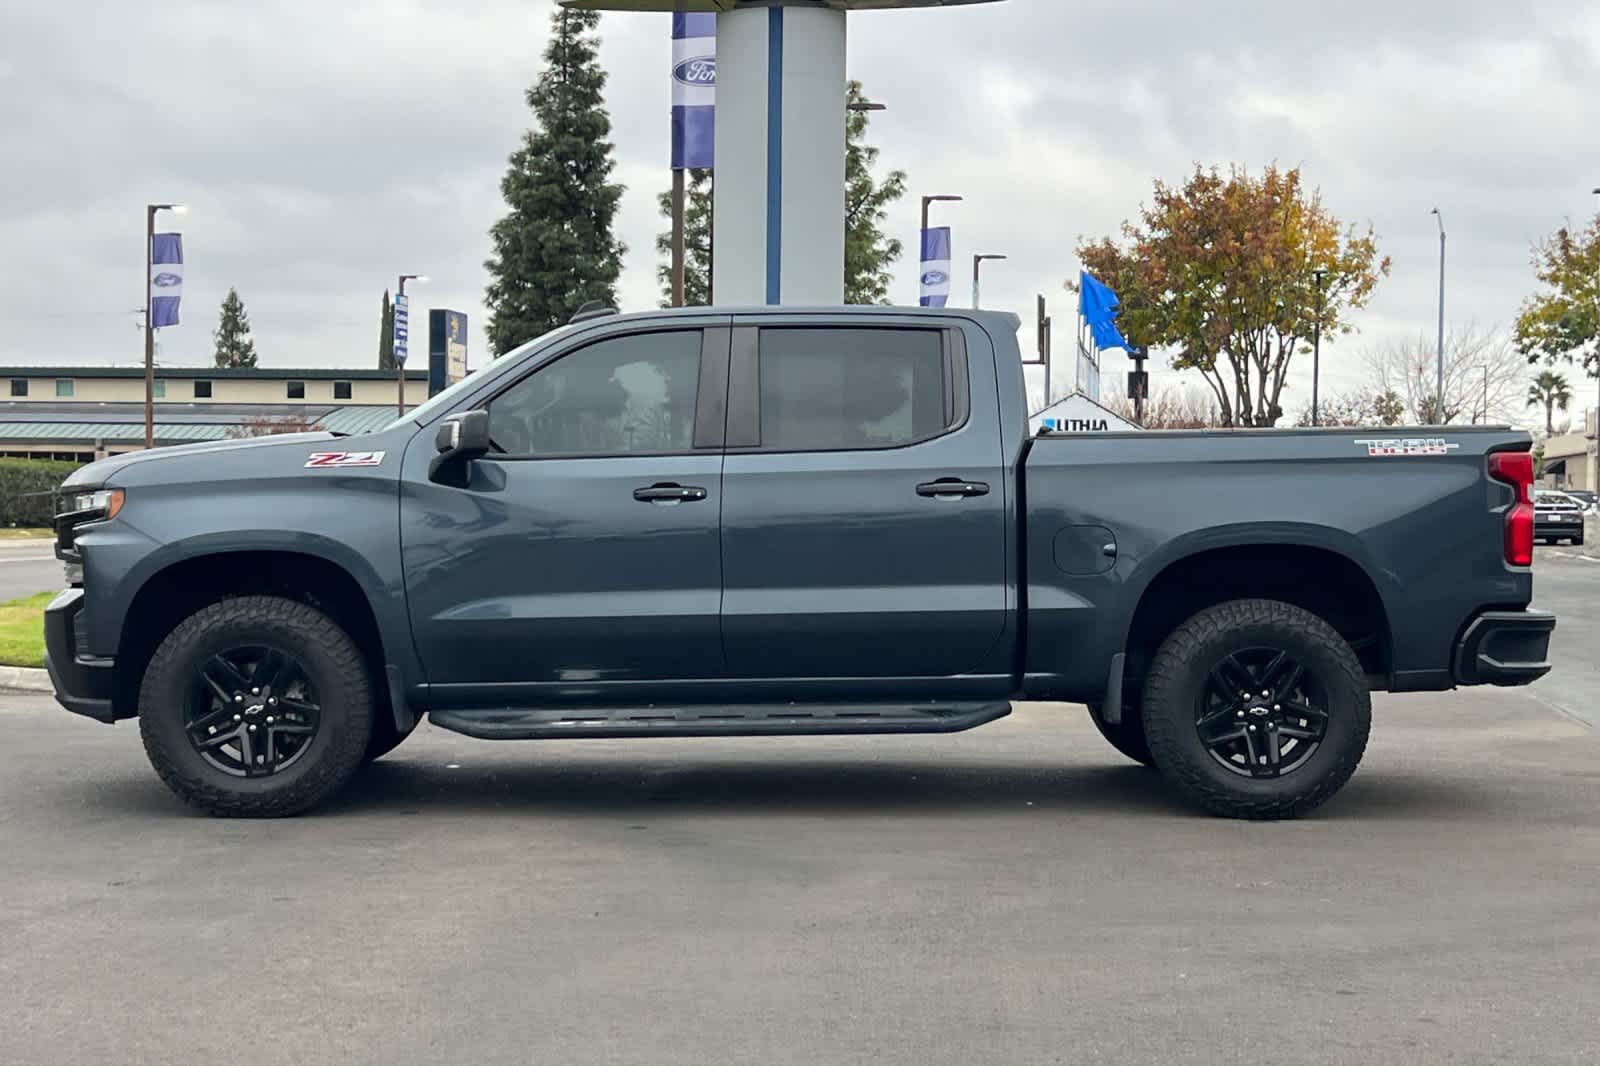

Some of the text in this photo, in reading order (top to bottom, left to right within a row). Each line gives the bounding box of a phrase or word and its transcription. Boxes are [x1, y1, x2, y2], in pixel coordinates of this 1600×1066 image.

[686, 60, 716, 81] For
[1057, 419, 1108, 431] LITHIA
[303, 450, 386, 468] Z71
